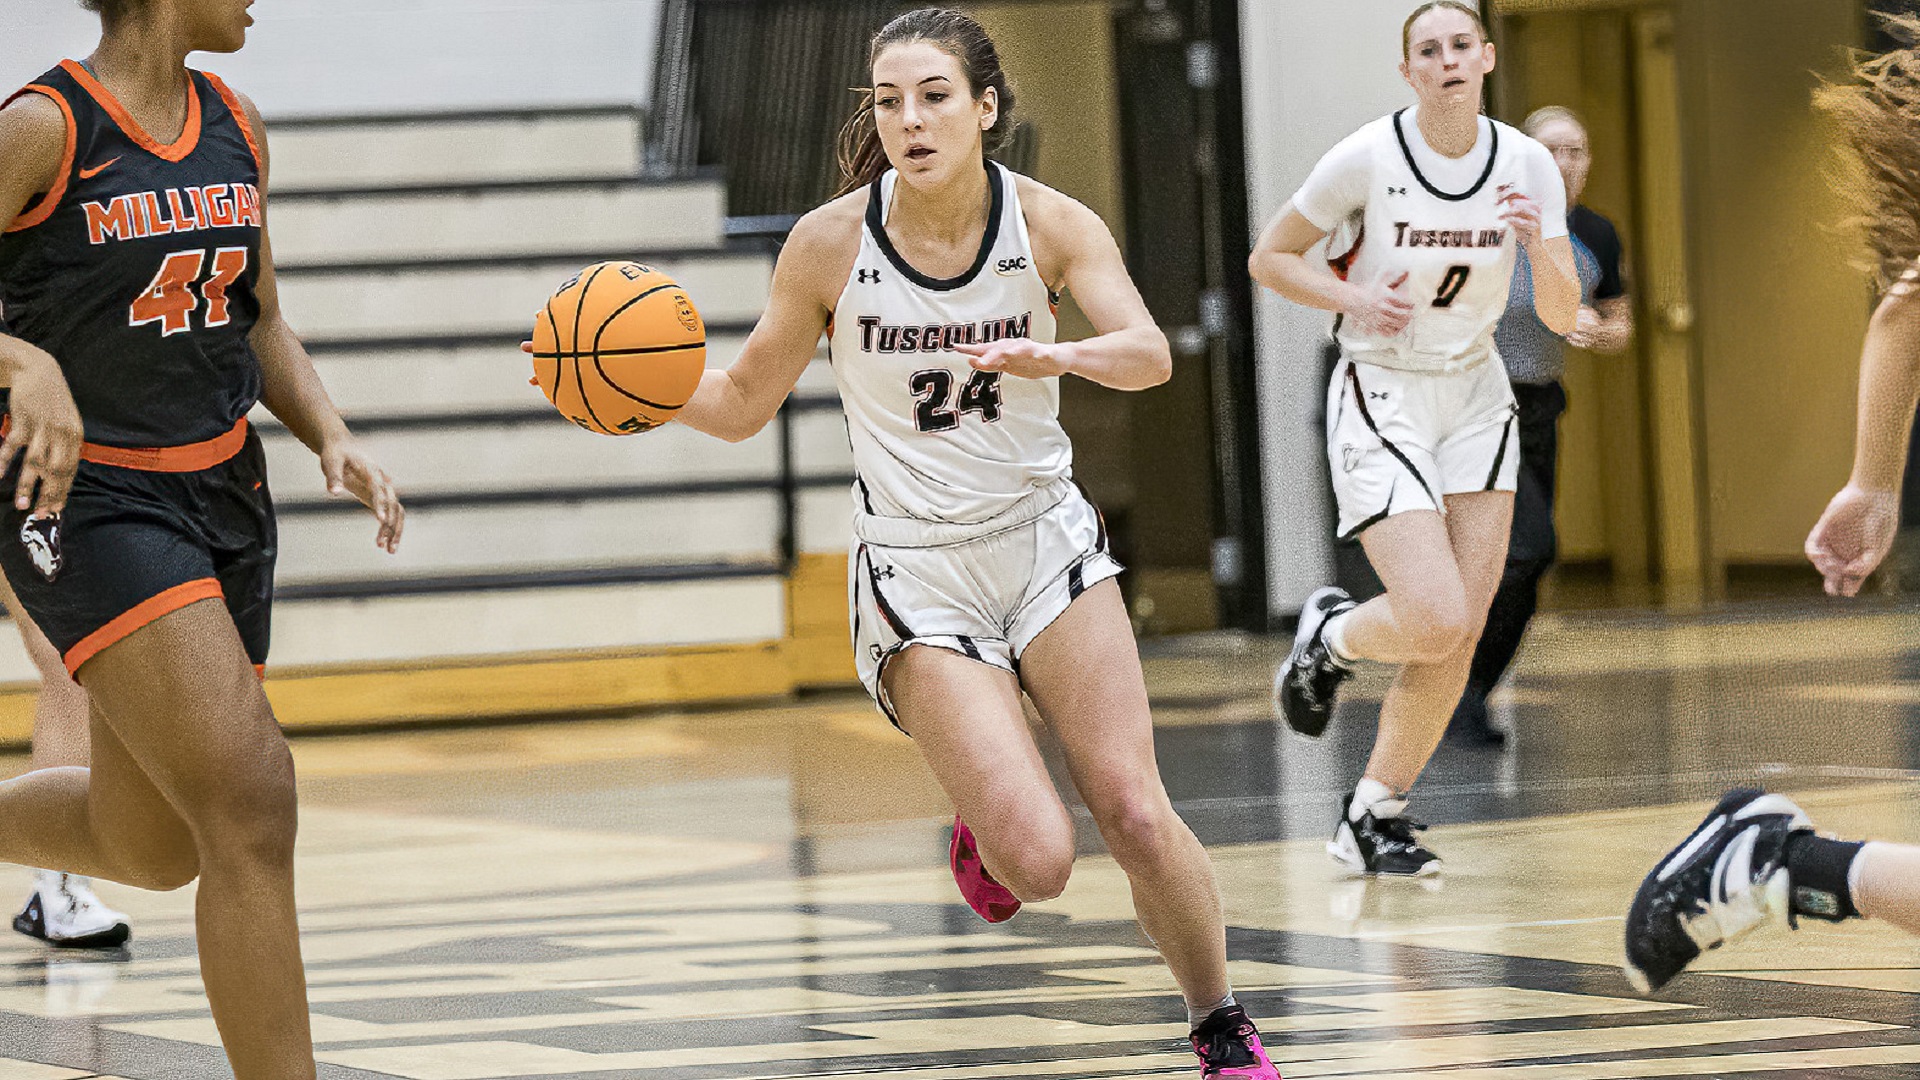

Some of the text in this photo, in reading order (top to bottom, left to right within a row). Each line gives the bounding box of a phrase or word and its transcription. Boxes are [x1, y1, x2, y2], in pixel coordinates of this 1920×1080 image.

[997, 256, 1027, 272] SAC
[1431, 264, 1471, 307] 0
[129, 246, 248, 337] 41
[909, 368, 1003, 433] 24
